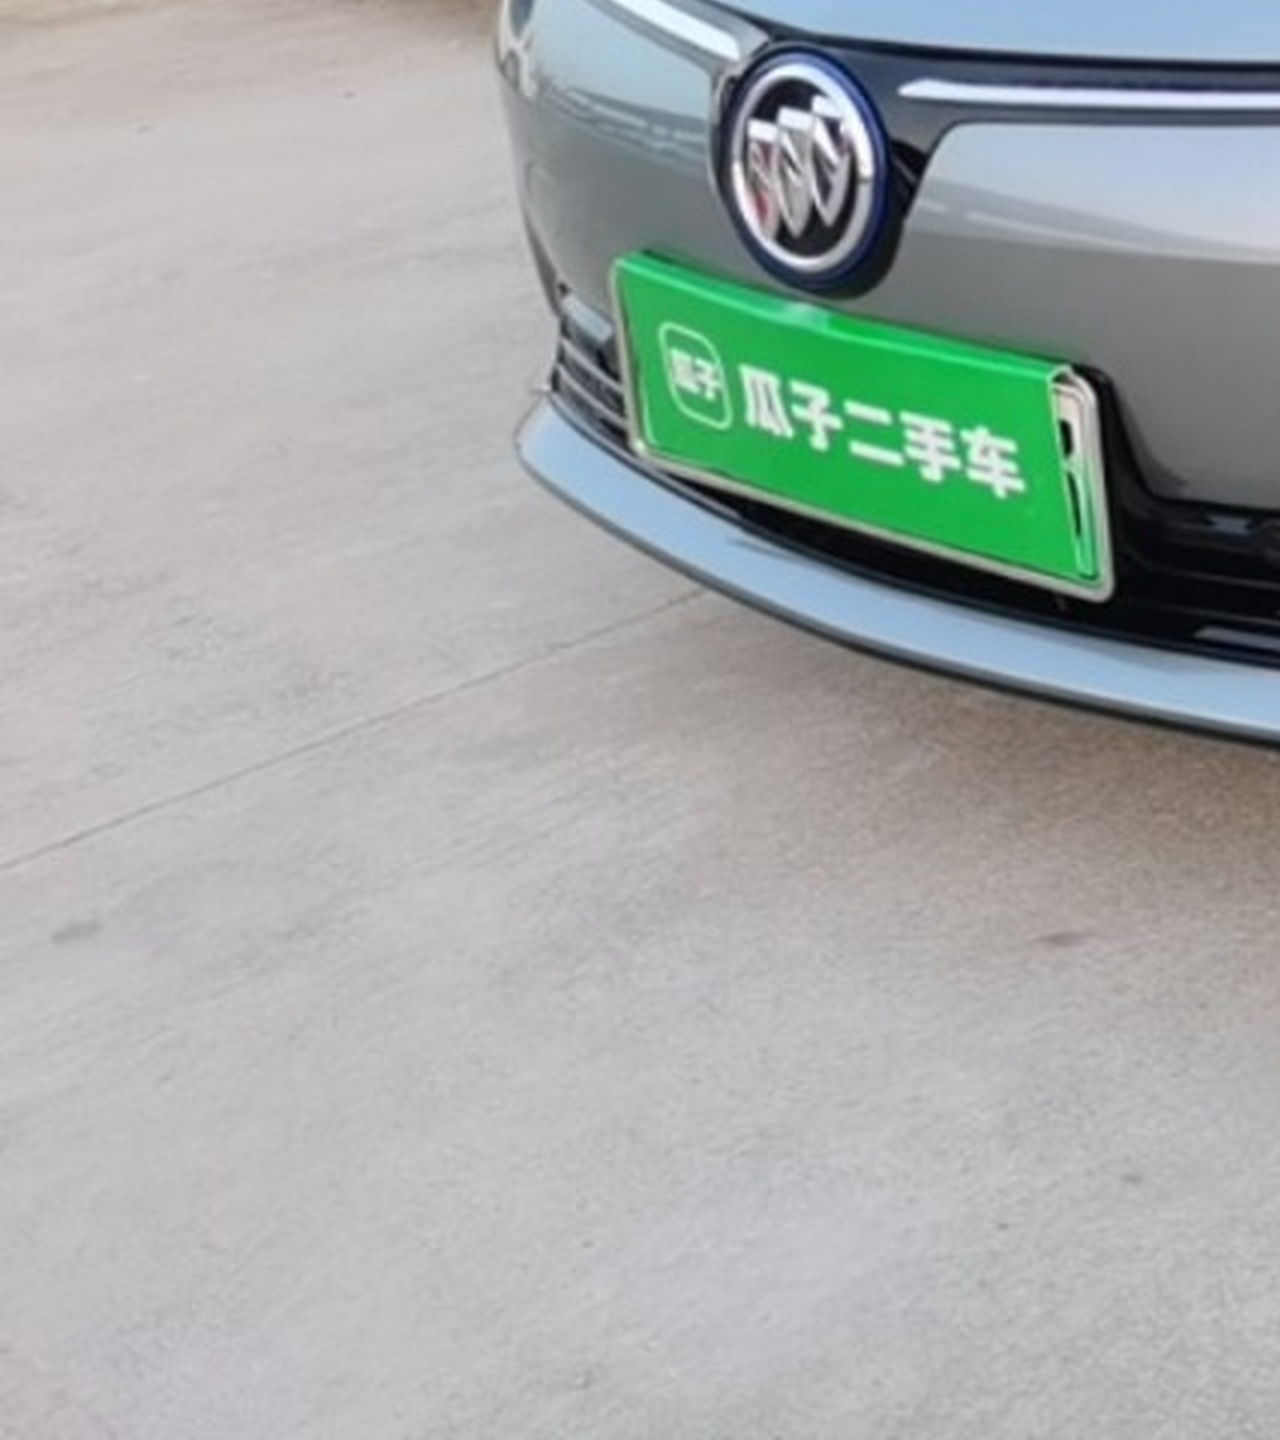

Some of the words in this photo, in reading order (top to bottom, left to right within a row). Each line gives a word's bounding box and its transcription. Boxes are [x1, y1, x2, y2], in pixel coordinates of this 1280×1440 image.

[738, 363, 1025, 498] 瓜子二手车
